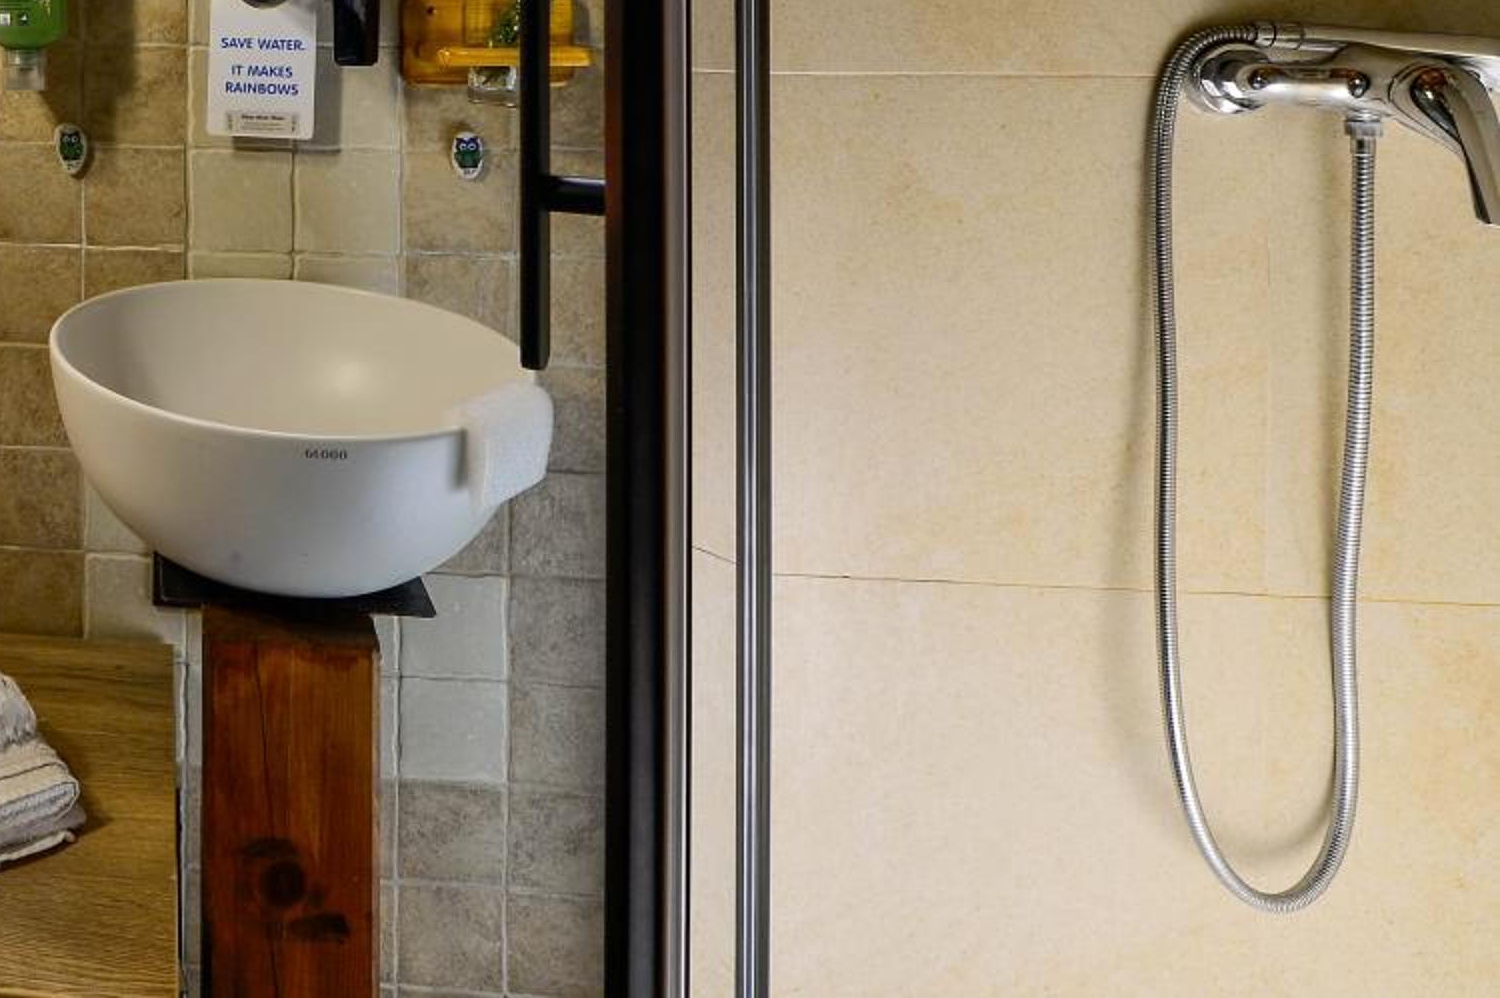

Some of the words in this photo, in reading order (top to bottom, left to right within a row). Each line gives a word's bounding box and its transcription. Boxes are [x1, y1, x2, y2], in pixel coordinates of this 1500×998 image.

[221, 37, 254, 49] SAVE
[231, 65, 245, 76] IT
[247, 65, 293, 78] MAKES
[225, 81, 299, 96] RAINBOWS
